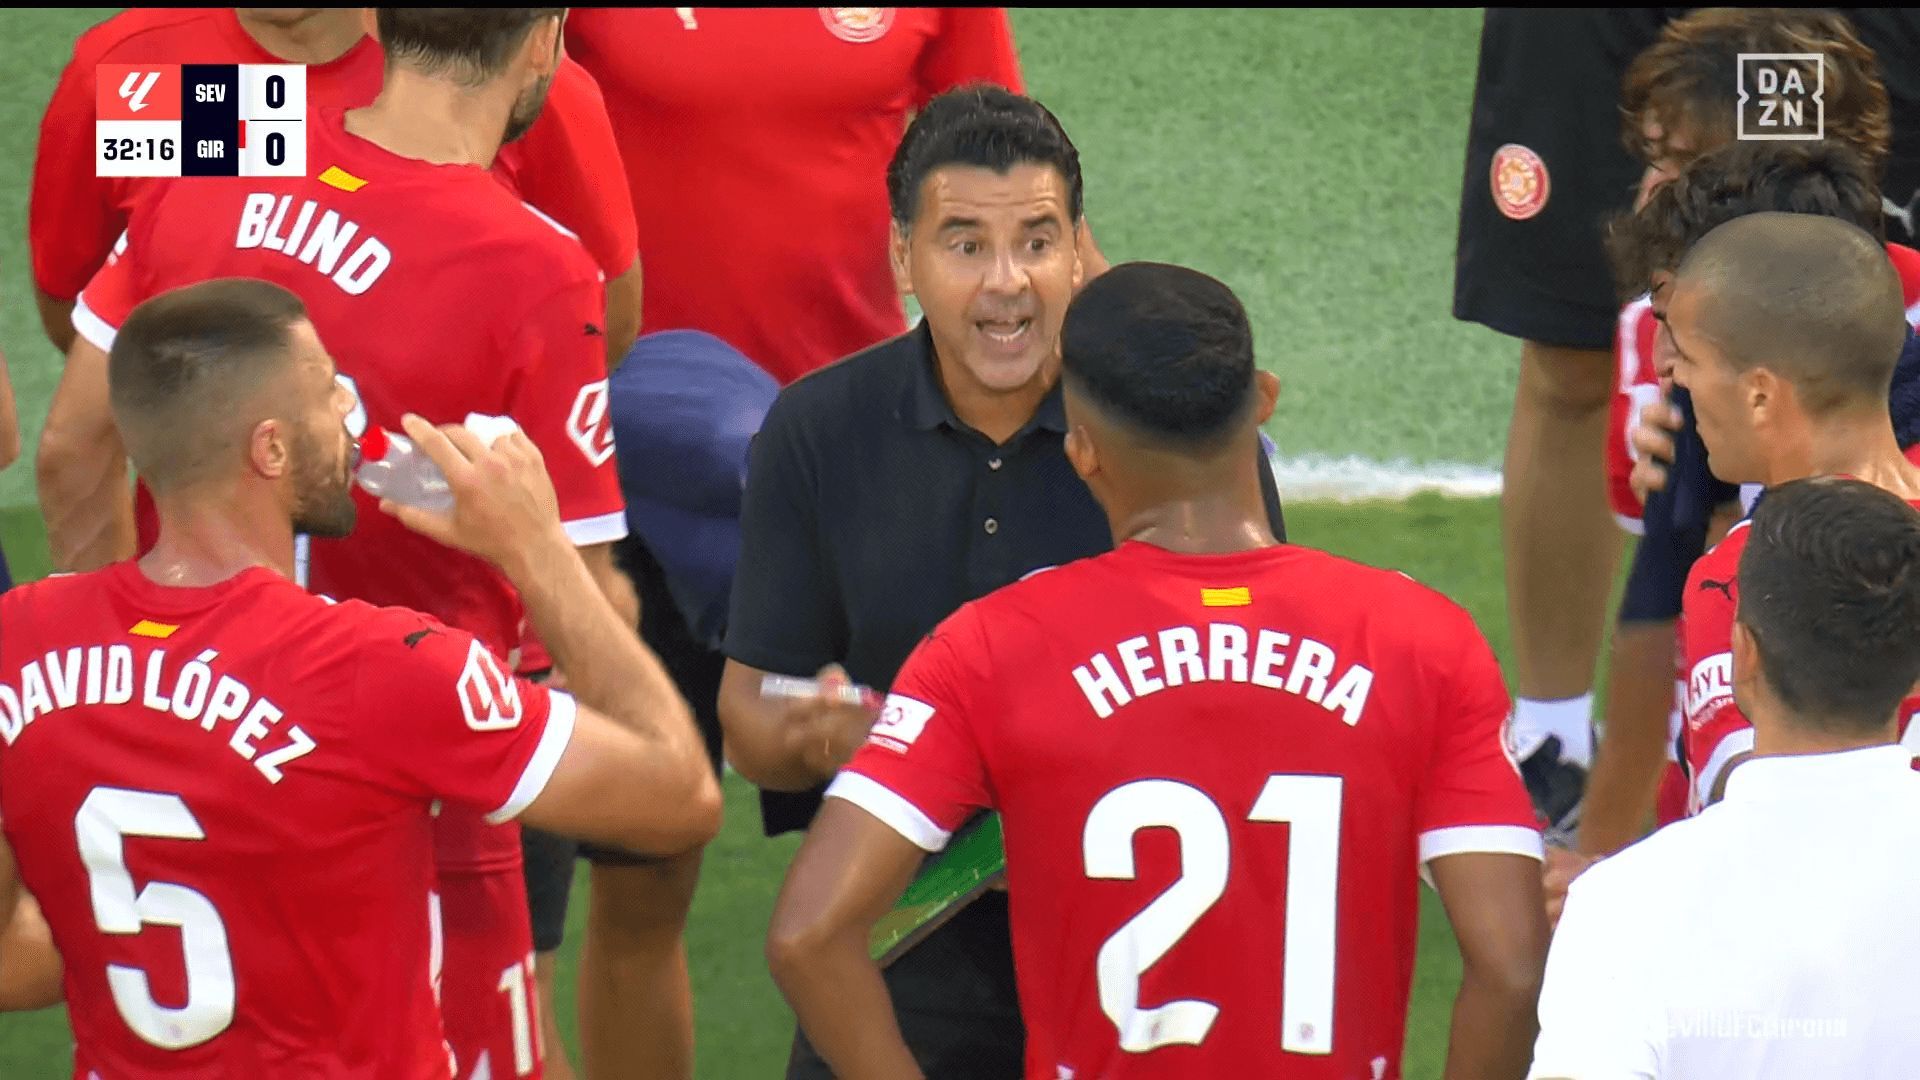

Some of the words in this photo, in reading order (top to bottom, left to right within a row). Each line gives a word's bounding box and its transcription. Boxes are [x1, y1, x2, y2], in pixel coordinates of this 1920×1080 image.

[235, 192, 392, 296] BLIND
[0, 643, 134, 747] DAVID
[143, 648, 318, 785] LÓPEZ
[1071, 621, 1375, 727] HERRERA
[73, 785, 236, 1050] 5
[1081, 773, 1344, 1055] 21
[498, 952, 536, 1077] 1
